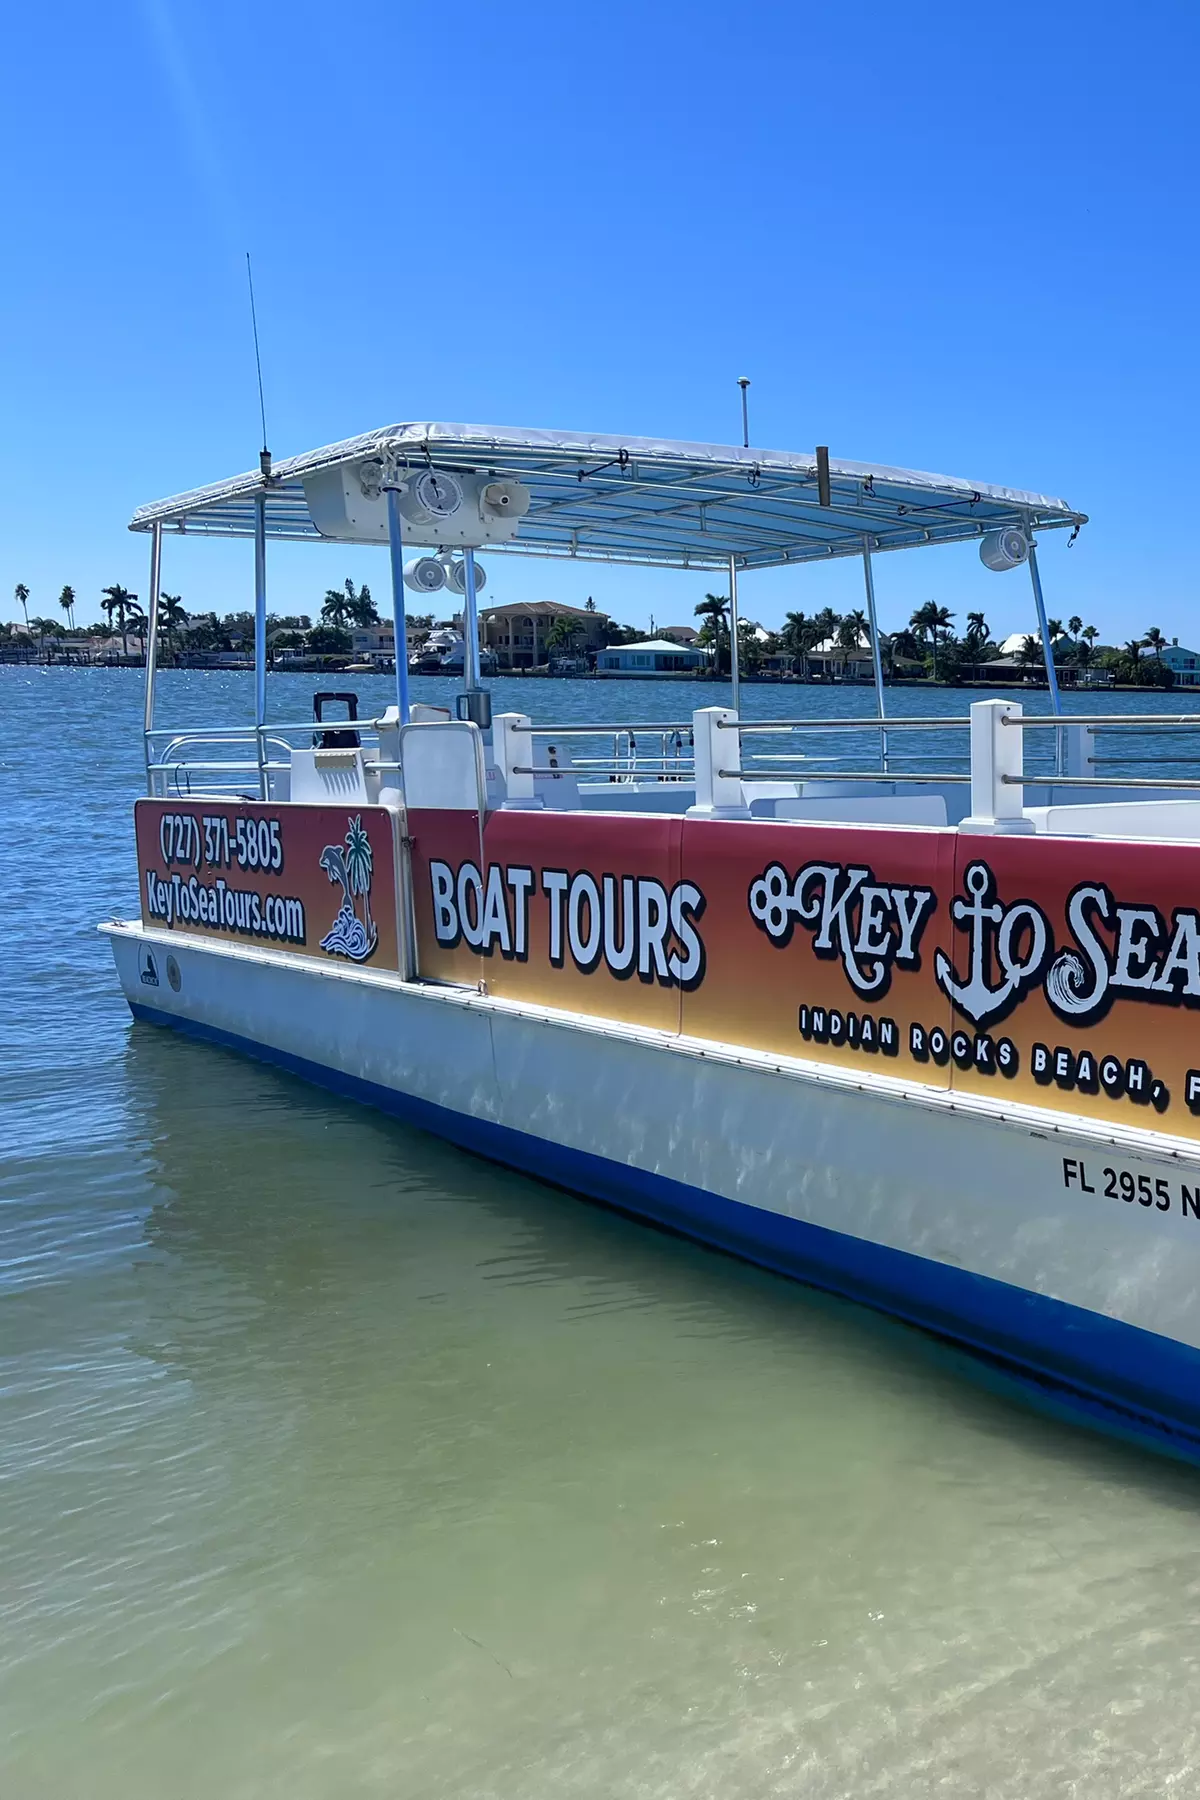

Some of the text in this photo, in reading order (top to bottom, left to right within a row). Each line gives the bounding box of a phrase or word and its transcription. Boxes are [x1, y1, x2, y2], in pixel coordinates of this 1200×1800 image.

[160, 812, 283, 873] (727) 371-5805
[146, 870, 304, 939] KeyToSeaTours.com
[431, 859, 701, 983] BOAT TOURS
[801, 1008, 894, 1045] INDIAN
[911, 1022, 1013, 1066] ROCKS
[1034, 1048, 1163, 1099] BEACH,
[1063, 1158, 1096, 1196] FL
[1102, 1166, 1172, 1213] 2955
